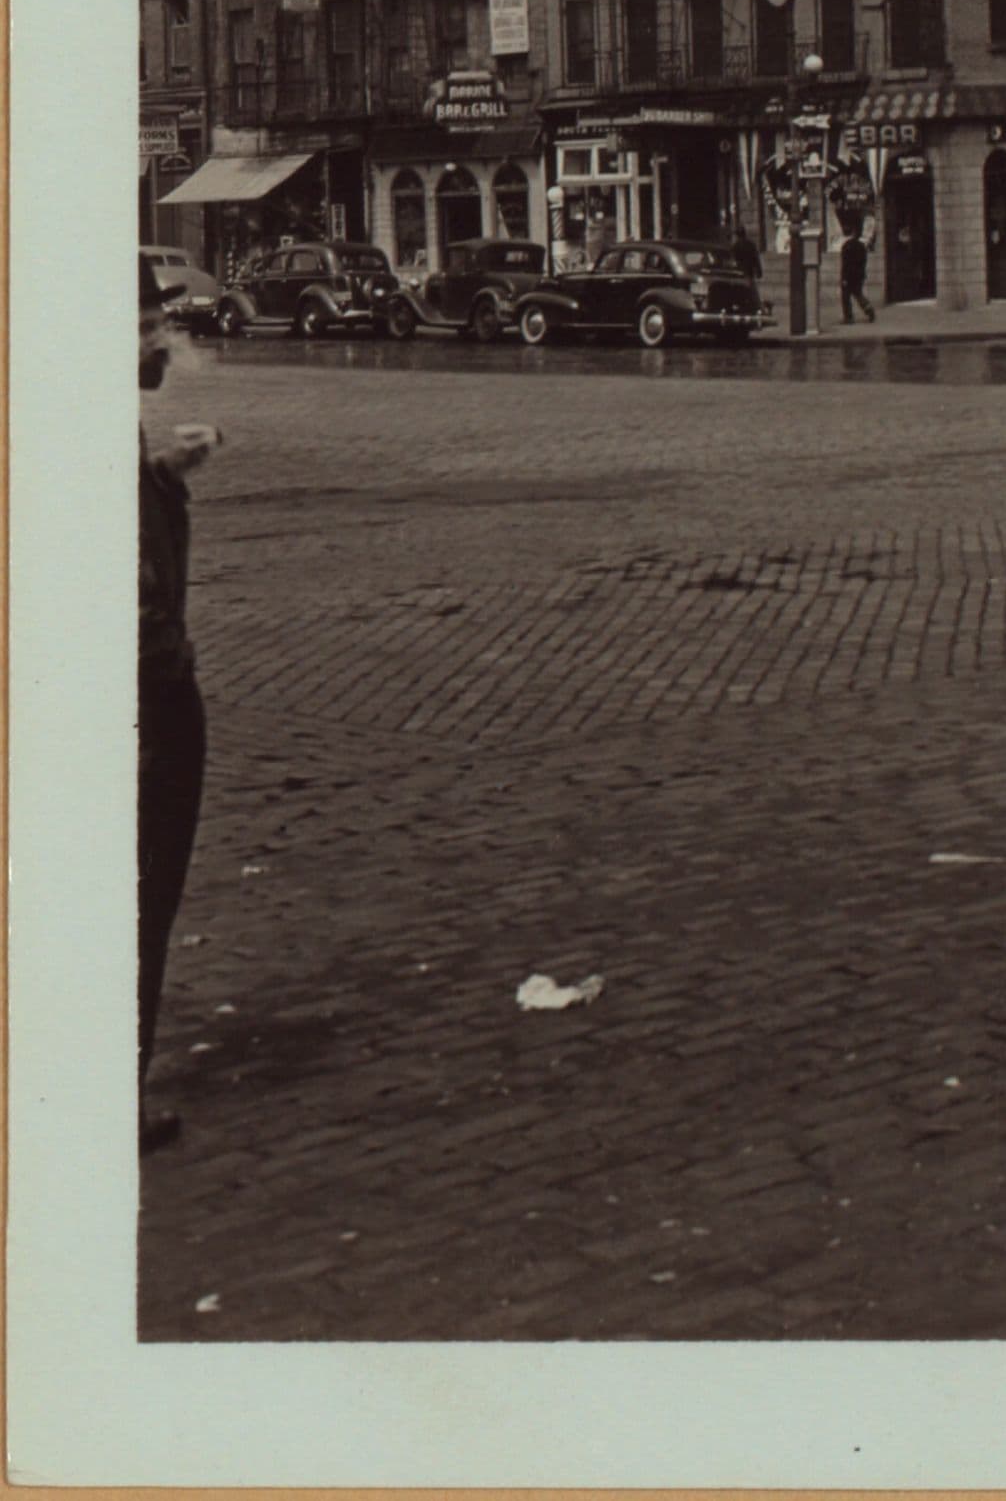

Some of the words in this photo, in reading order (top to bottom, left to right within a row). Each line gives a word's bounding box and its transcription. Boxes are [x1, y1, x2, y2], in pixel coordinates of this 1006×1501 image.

[436, 103, 462, 120] BAR
[471, 101, 508, 117] GRILL
[860, 124, 916, 144] BAR
